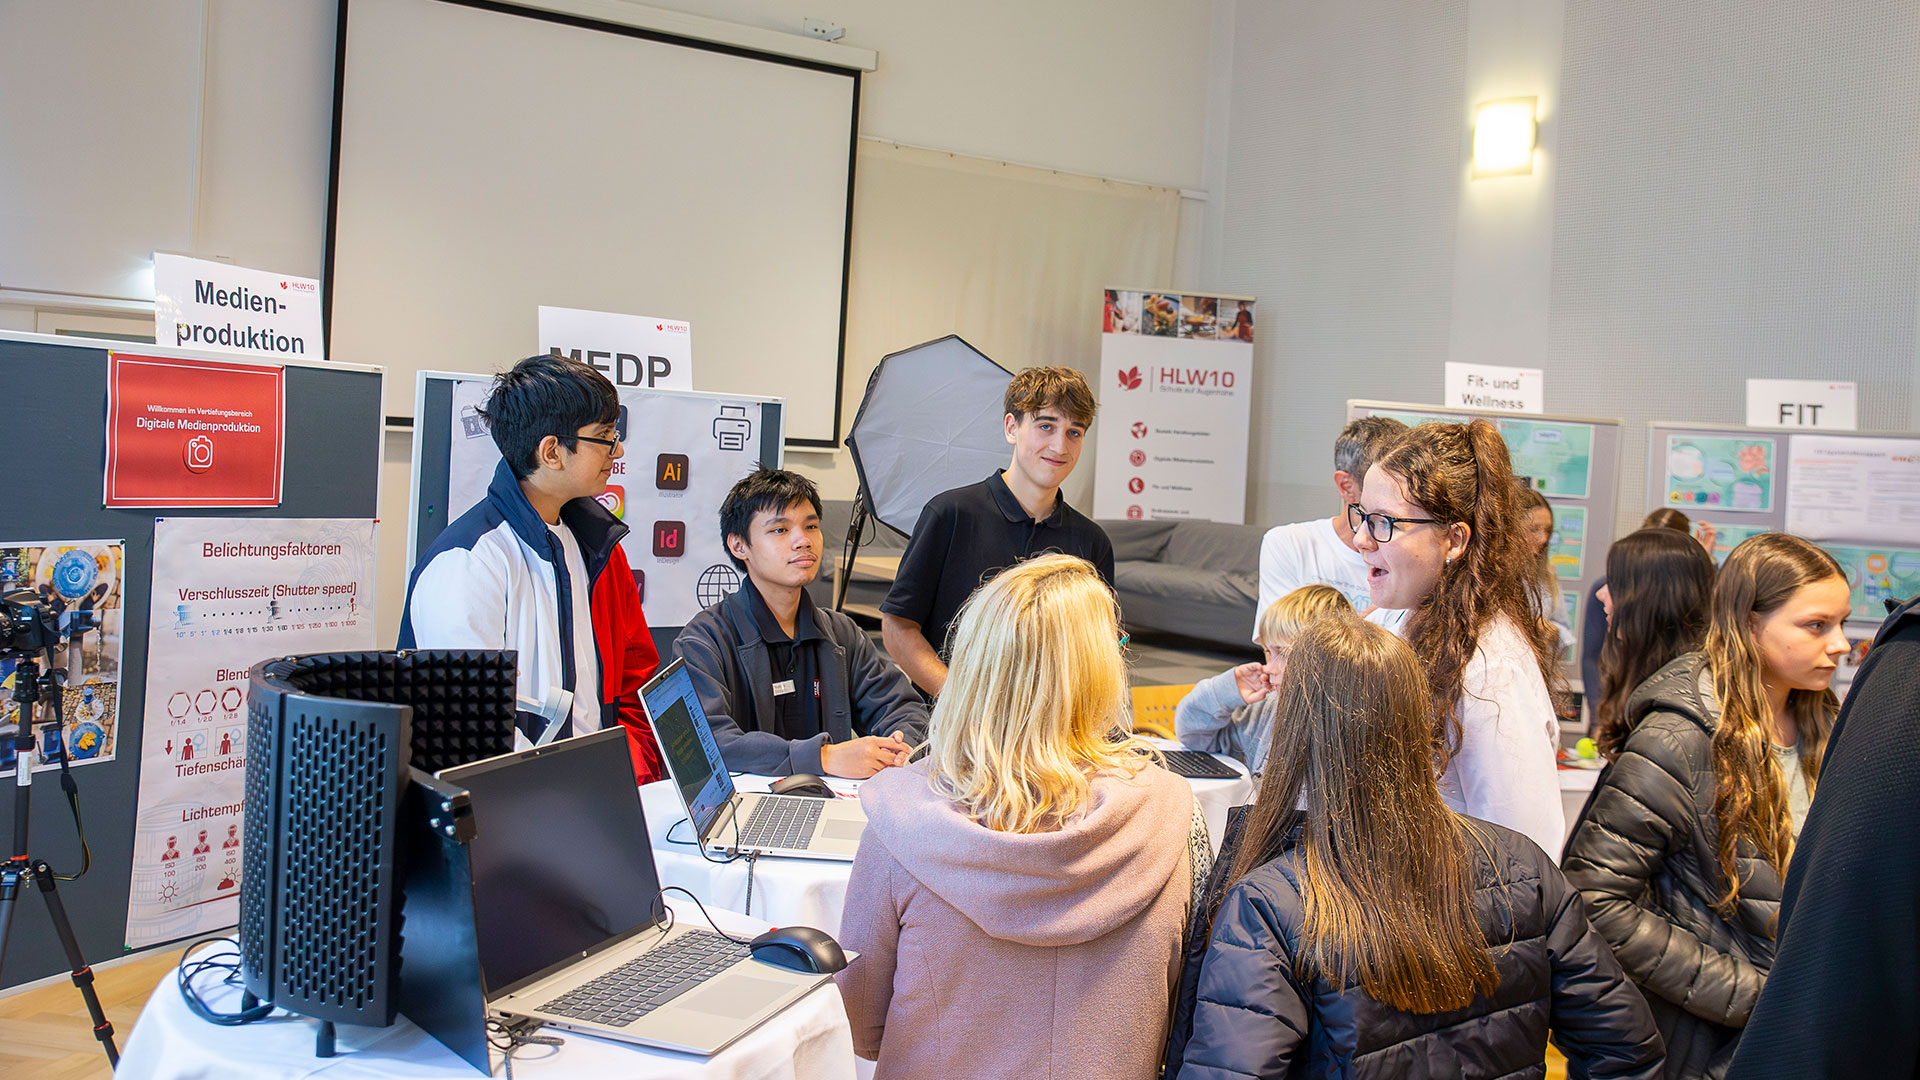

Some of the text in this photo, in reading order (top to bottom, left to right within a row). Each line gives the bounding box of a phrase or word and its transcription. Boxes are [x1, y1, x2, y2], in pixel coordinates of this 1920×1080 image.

[195, 279, 286, 314] Medien-
[176, 323, 304, 354] produktion
[1160, 367, 1235, 387] HLW10
[1467, 374, 1519, 390] Fit- und
[147, 404, 187, 414] Willkommen
[197, 407, 253, 418] Vertiefungsbereich
[1462, 394, 1524, 409] Wellness
[1779, 403, 1823, 425] FIT
[136, 416, 261, 433] Digitale Medienproduktion
[663, 462, 682, 481] Ai
[660, 529, 678, 548] Id
[203, 542, 341, 560] Belichtungsfaktoren
[178, 582, 357, 601] Verschlusszeit (Shutter speed)
[217, 667, 251, 681] Blend
[175, 757, 247, 777] Tiefenschär
[183, 800, 245, 822] Lichtempf
[164, 870, 176, 878] 100
